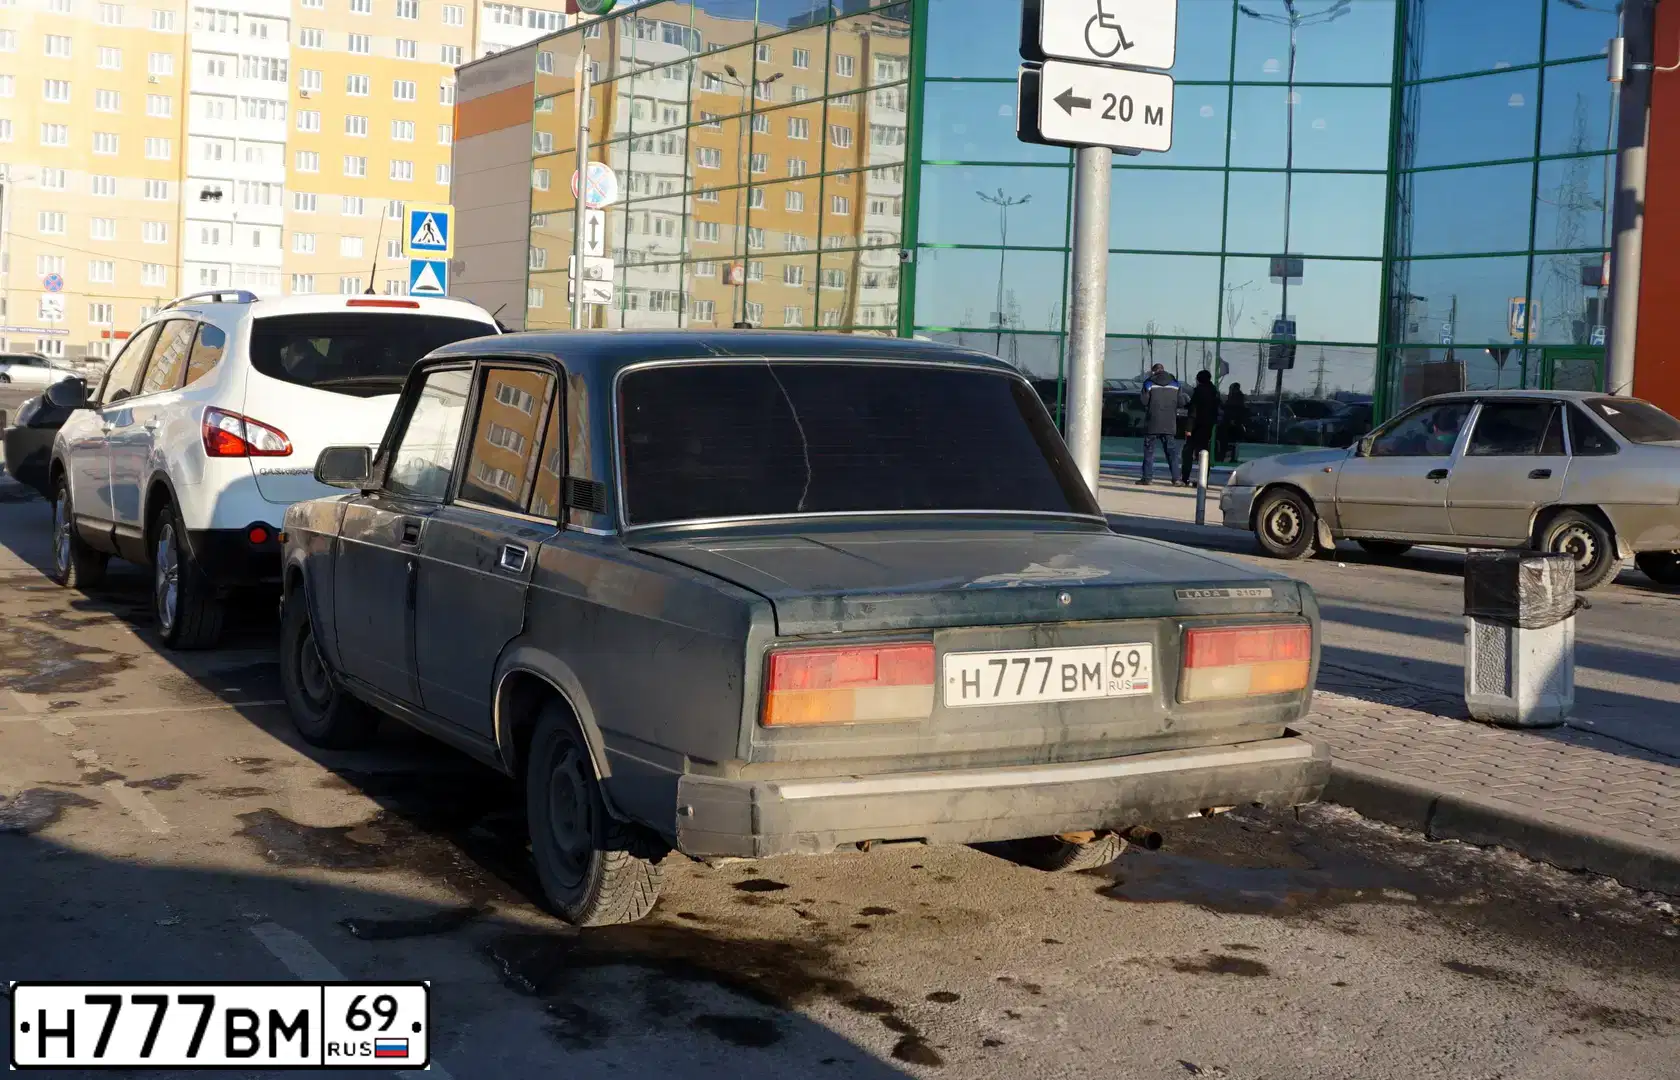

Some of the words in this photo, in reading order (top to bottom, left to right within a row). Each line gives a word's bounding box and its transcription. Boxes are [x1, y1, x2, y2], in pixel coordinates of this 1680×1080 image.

[1101, 93, 1133, 122] 20
[1185, 590, 1220, 598] LADA
[1111, 650, 1141, 678] 69
[1109, 680, 1131, 691] RUS
